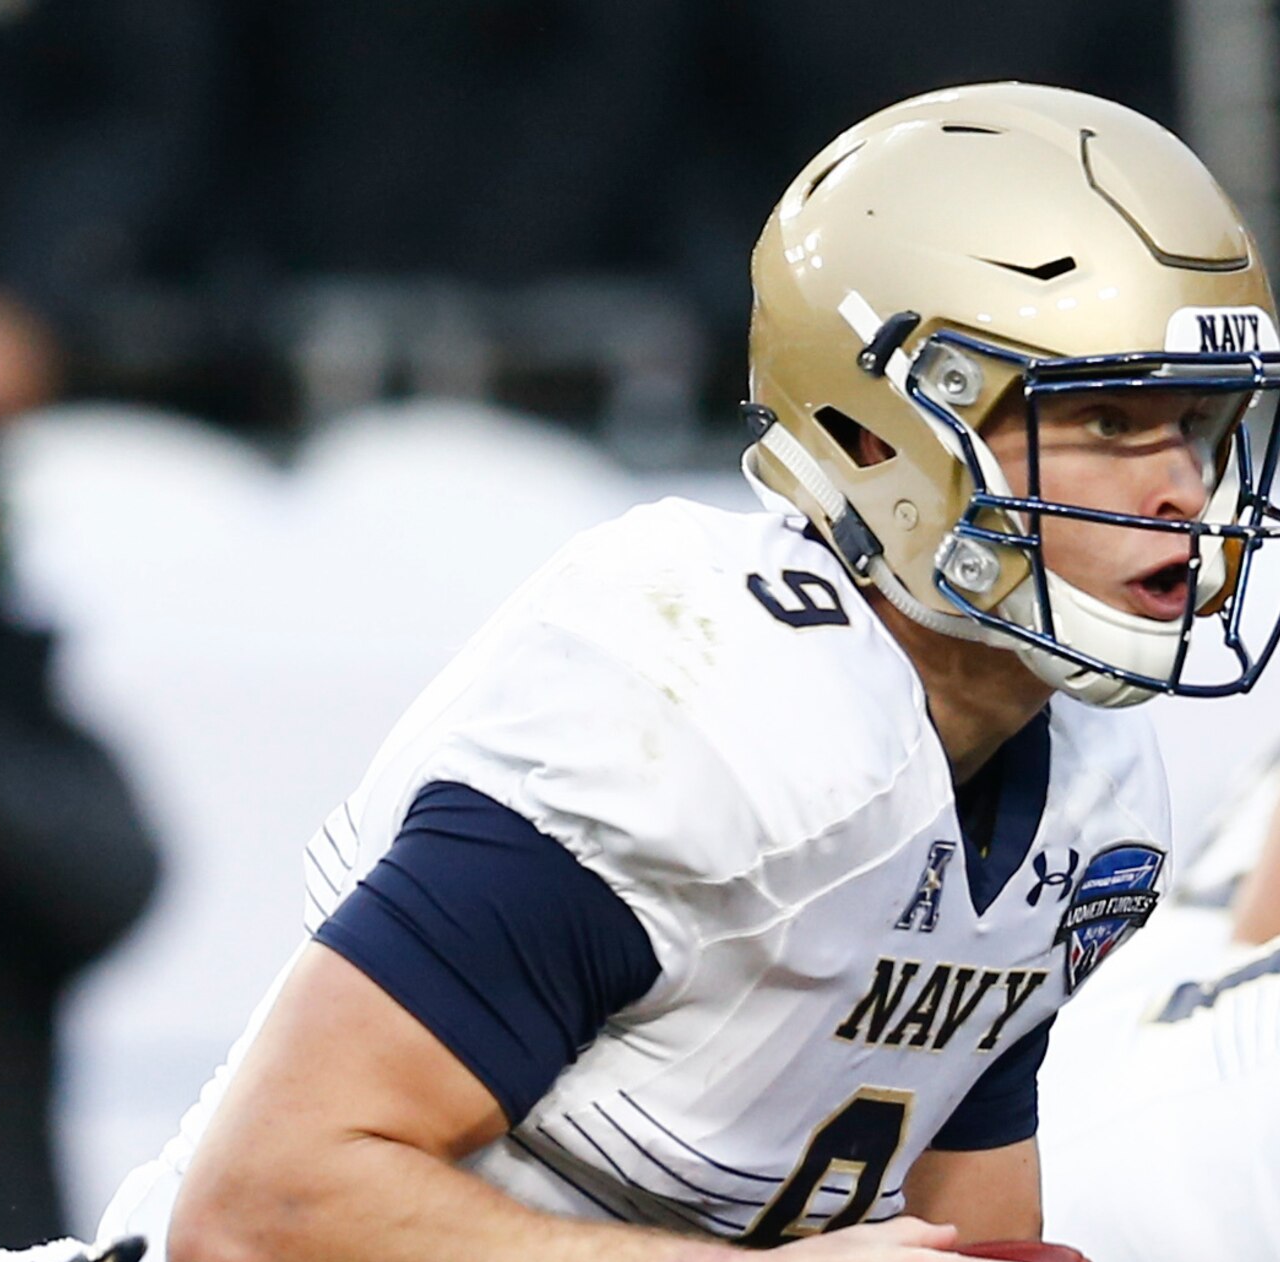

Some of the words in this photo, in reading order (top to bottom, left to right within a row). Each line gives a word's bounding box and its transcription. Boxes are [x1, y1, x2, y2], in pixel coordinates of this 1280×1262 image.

[1196, 313, 1260, 352] NAVY
[745, 569, 851, 628] 9
[833, 955, 1051, 1053] NAVY
